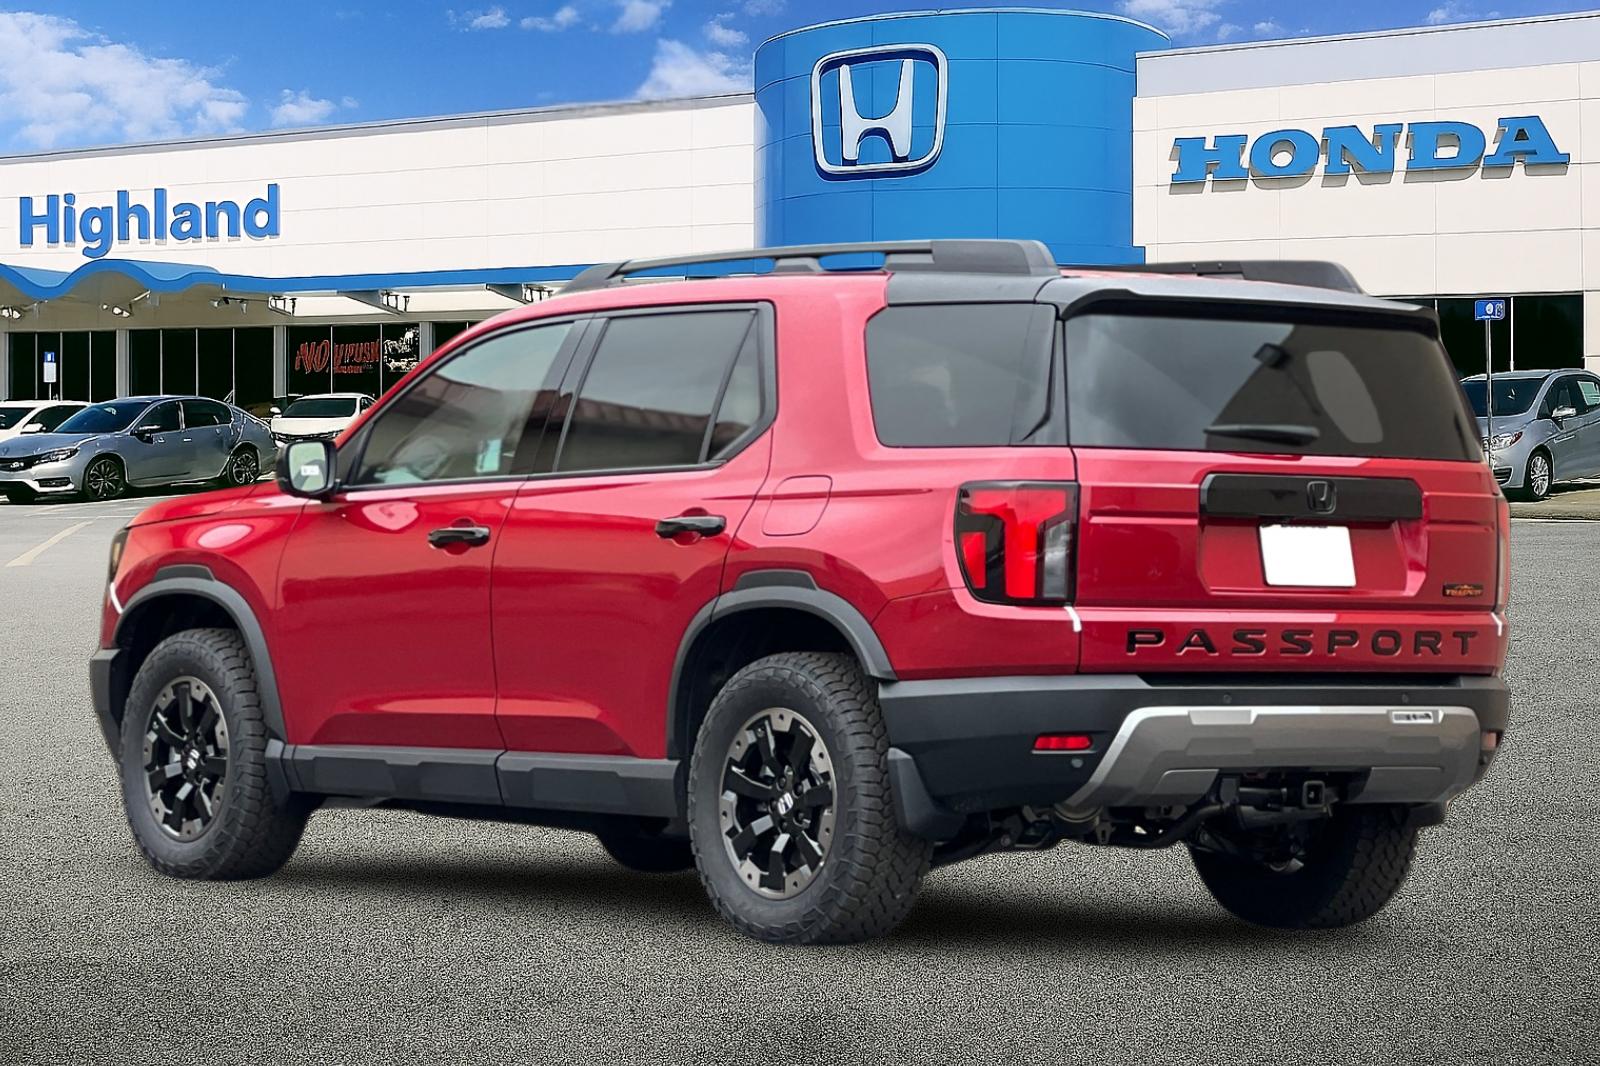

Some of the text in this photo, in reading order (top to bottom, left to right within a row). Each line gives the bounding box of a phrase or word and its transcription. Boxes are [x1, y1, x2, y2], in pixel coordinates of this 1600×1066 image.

[1170, 115, 1571, 183] HONDA
[19, 183, 280, 258] Highland
[1126, 628, 1478, 656] PASSPORT
